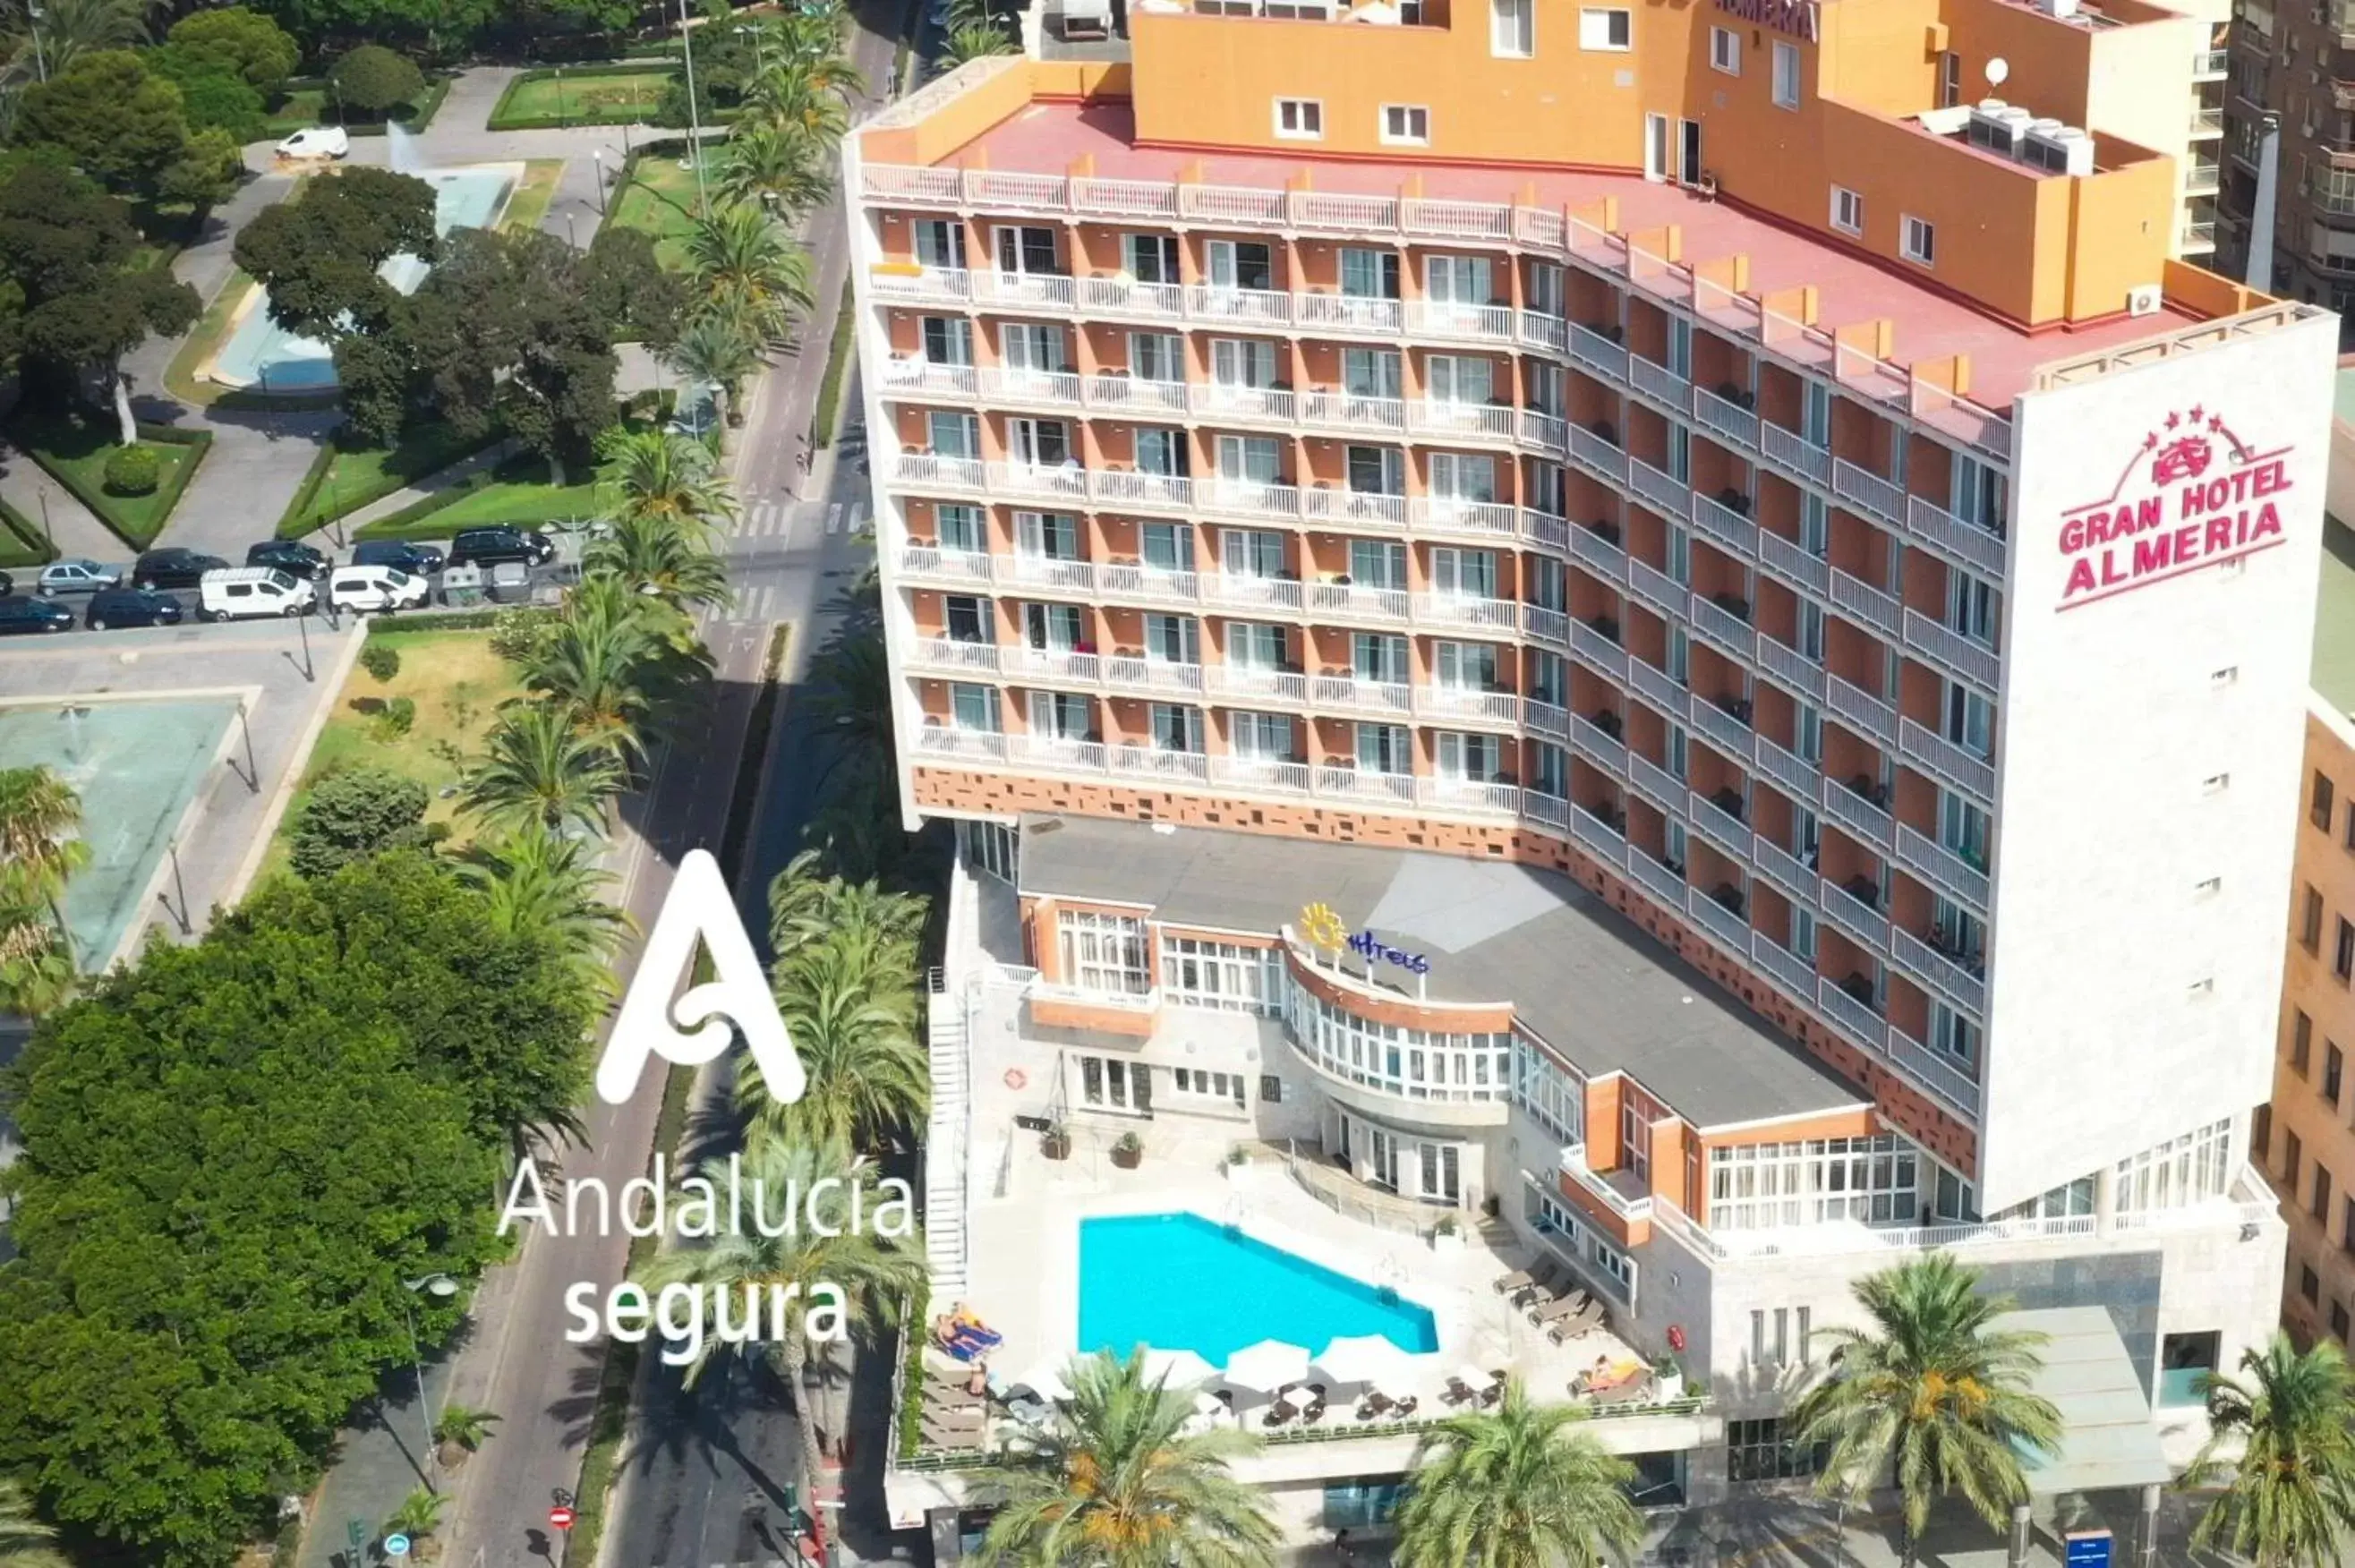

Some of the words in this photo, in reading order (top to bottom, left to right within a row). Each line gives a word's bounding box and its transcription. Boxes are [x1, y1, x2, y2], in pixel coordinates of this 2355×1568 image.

[2060, 497, 2163, 556] GRAN
[2182, 460, 2293, 517] HOTEL
[2061, 502, 2282, 599] ALMERIA
